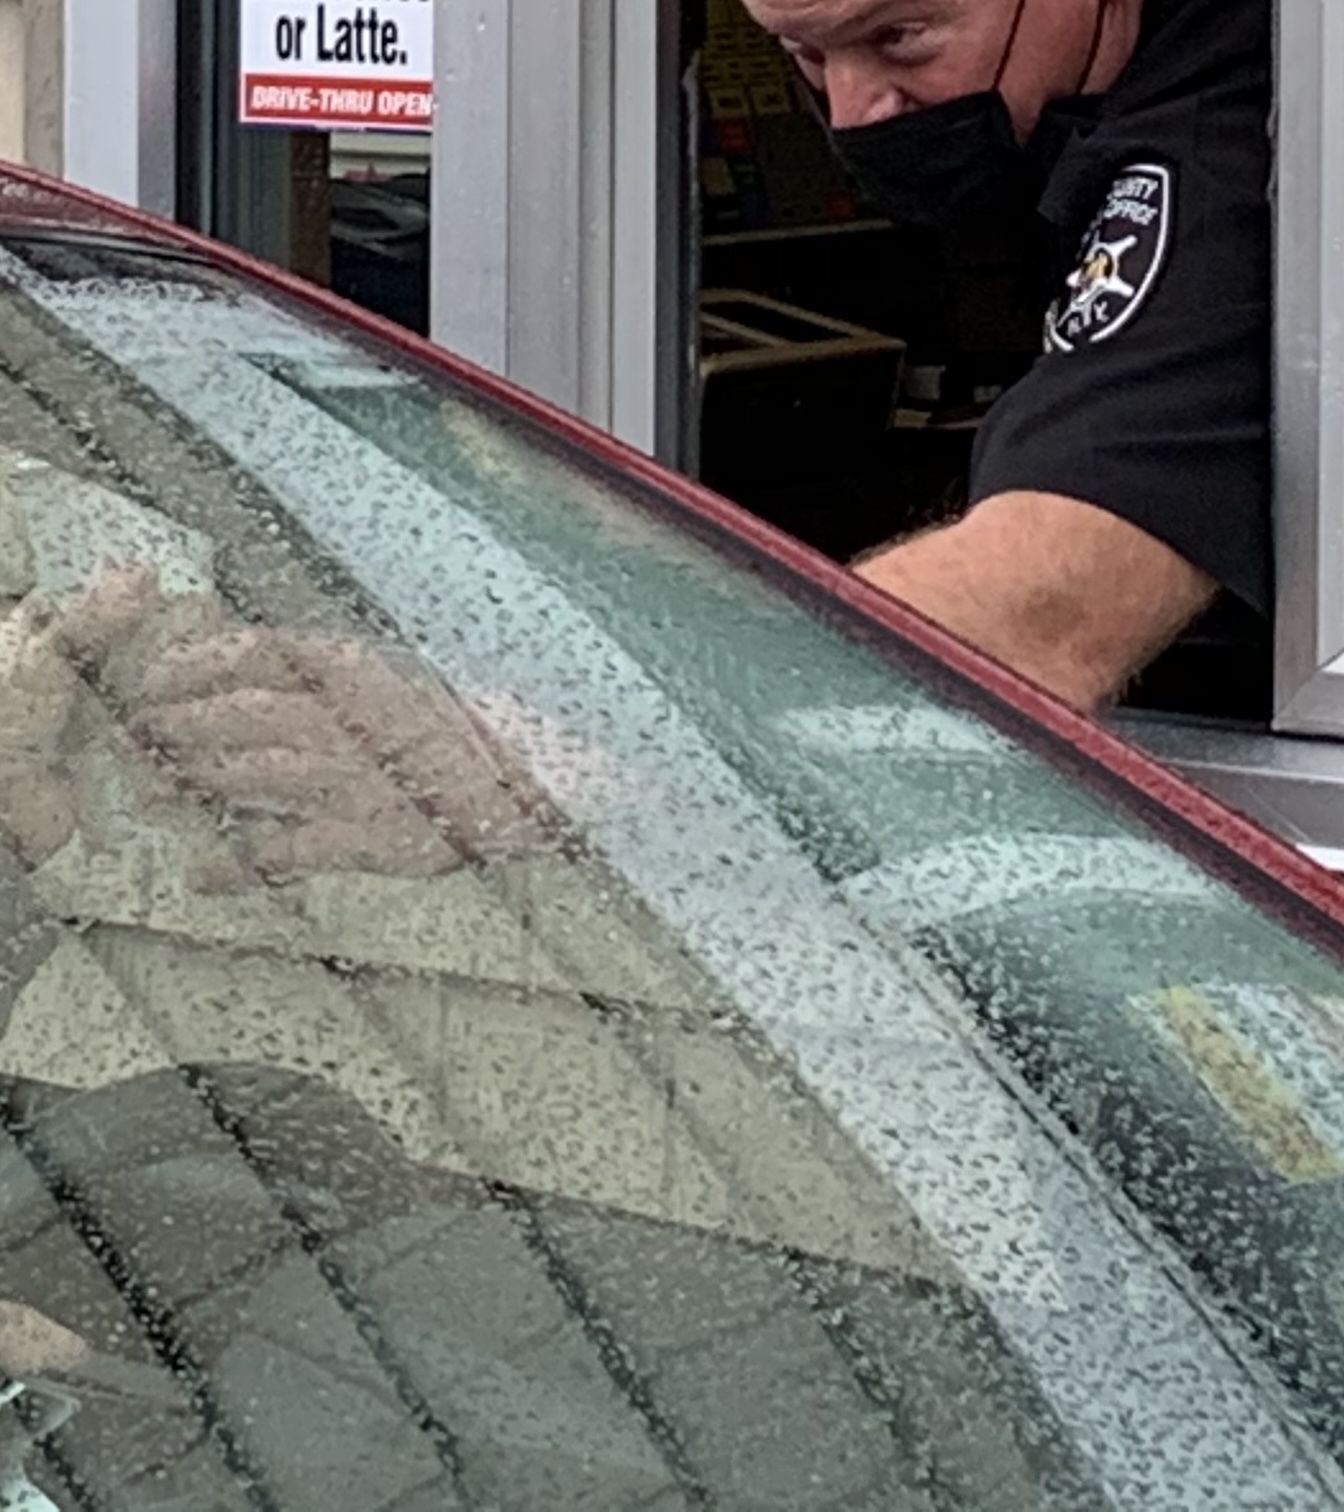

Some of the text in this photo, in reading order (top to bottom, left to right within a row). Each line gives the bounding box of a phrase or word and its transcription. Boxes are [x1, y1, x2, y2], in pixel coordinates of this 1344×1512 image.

[275, 4, 408, 65] or Latte.
[251, 85, 433, 117] DRIVE-THRU OPEN
